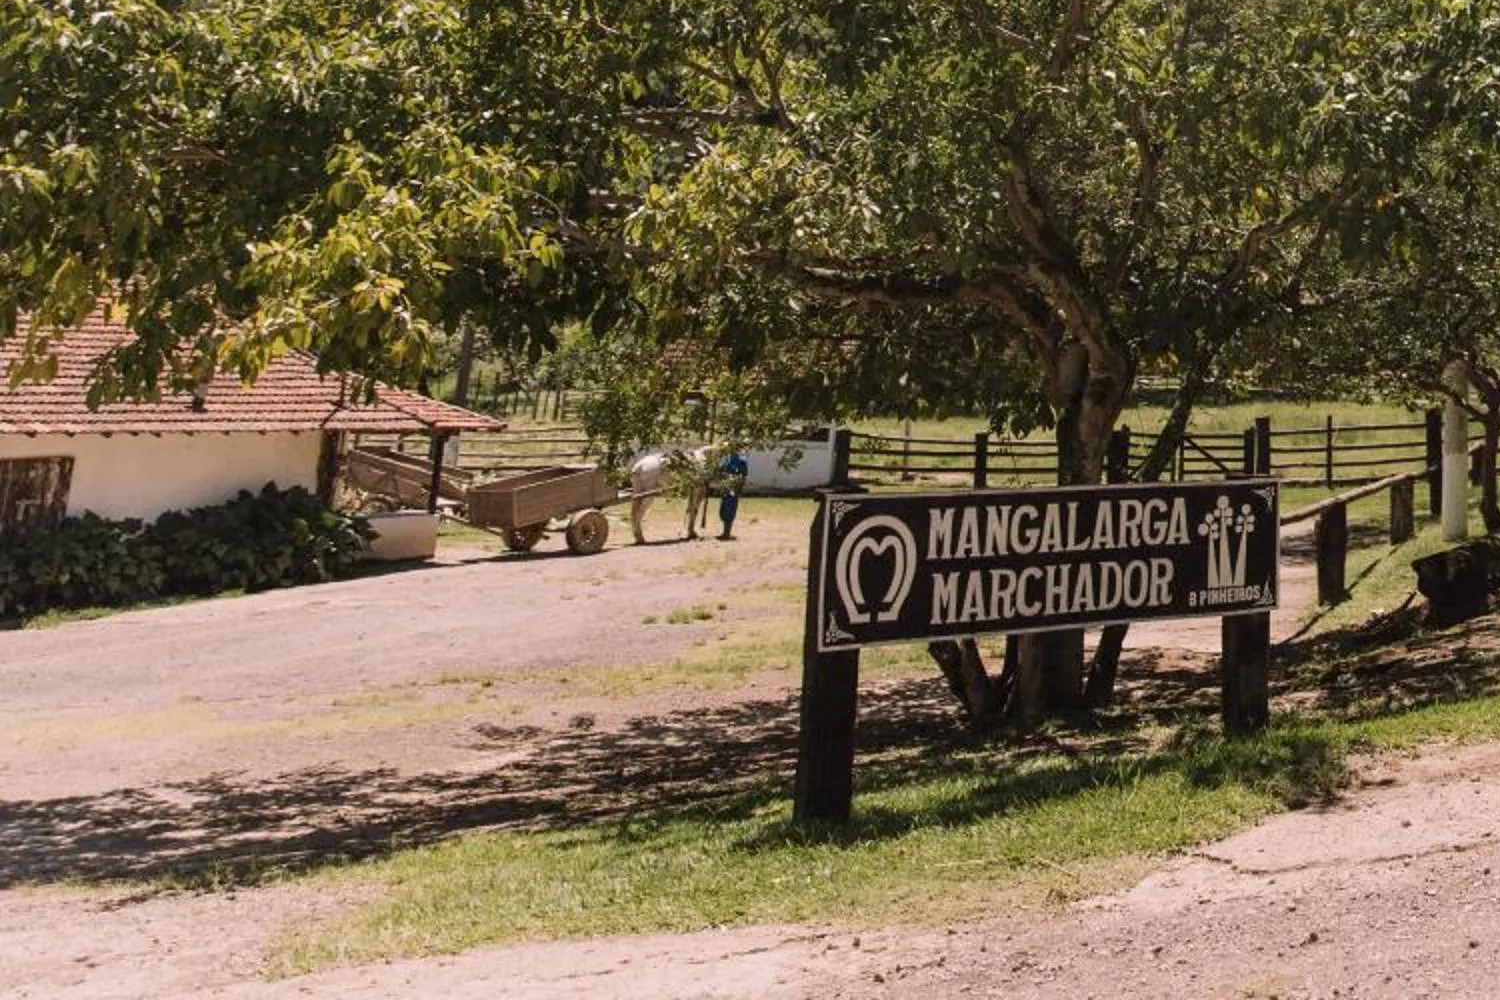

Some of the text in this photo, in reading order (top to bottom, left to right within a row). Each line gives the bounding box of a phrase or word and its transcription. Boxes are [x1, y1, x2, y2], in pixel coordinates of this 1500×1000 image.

[927, 498, 1190, 559] MANGALARGA
[930, 558, 1174, 625] MARCHADOR
[1199, 585, 1261, 606] PINHEIROS
